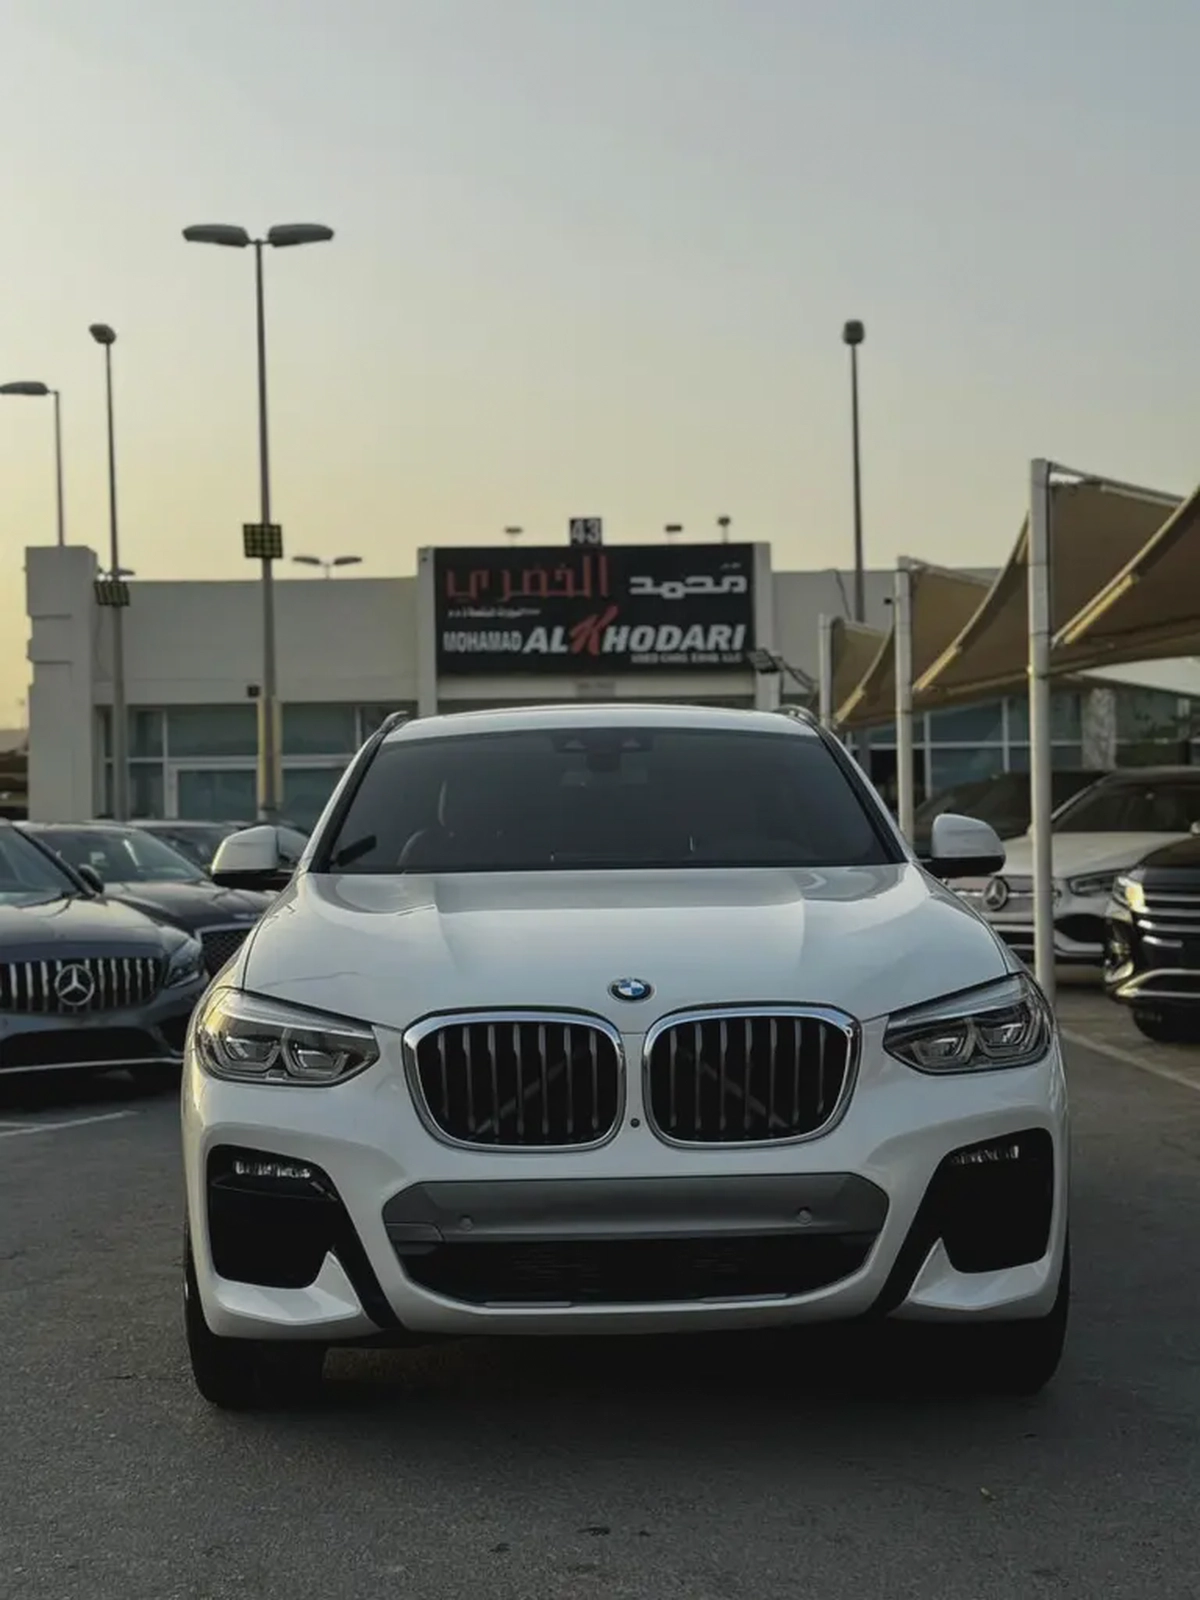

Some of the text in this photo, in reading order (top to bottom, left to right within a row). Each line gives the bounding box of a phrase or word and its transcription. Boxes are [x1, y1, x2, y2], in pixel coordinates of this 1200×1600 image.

[572, 519, 600, 544] 43
[629, 575, 747, 599] محمد
[443, 630, 523, 652] MOHAMAD
